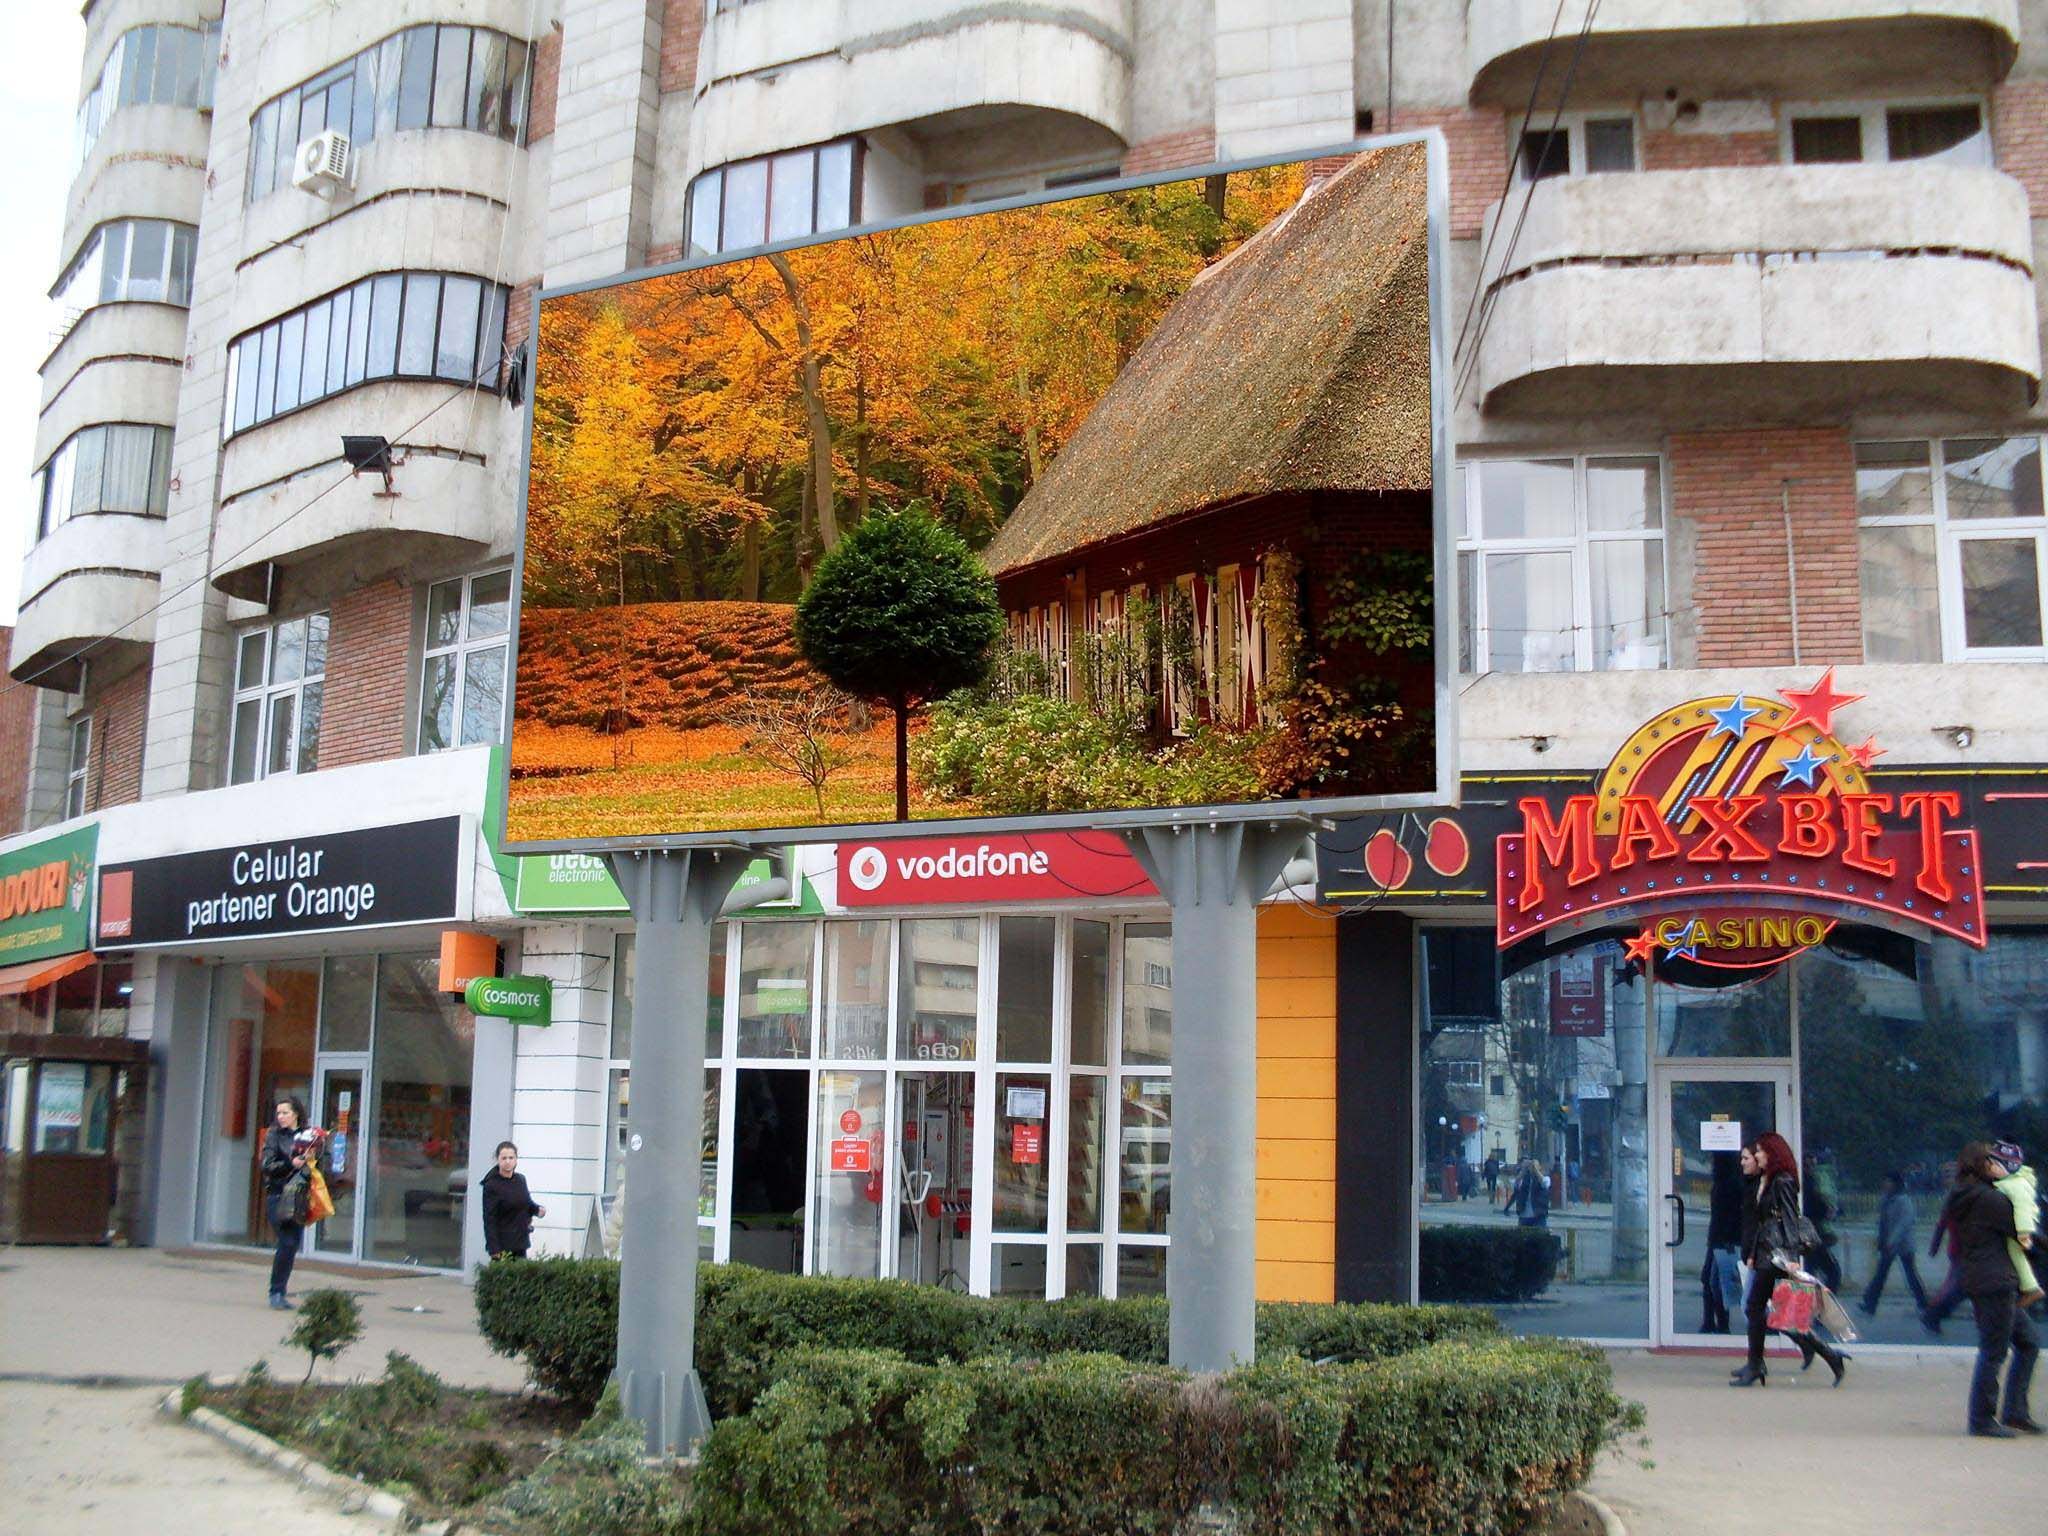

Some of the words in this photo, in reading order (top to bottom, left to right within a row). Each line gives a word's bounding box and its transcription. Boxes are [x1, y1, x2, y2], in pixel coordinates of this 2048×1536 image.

[232, 846, 324, 885] Celular
[896, 845, 1049, 880] vodafone
[1518, 792, 1961, 912] MAXBET
[0, 860, 69, 921] DOURI
[549, 868, 606, 882] electronic
[187, 891, 277, 935] partener
[287, 882, 375, 921] Orange
[1654, 916, 1828, 950] CASINO
[484, 989, 541, 1008] COSMOTE
